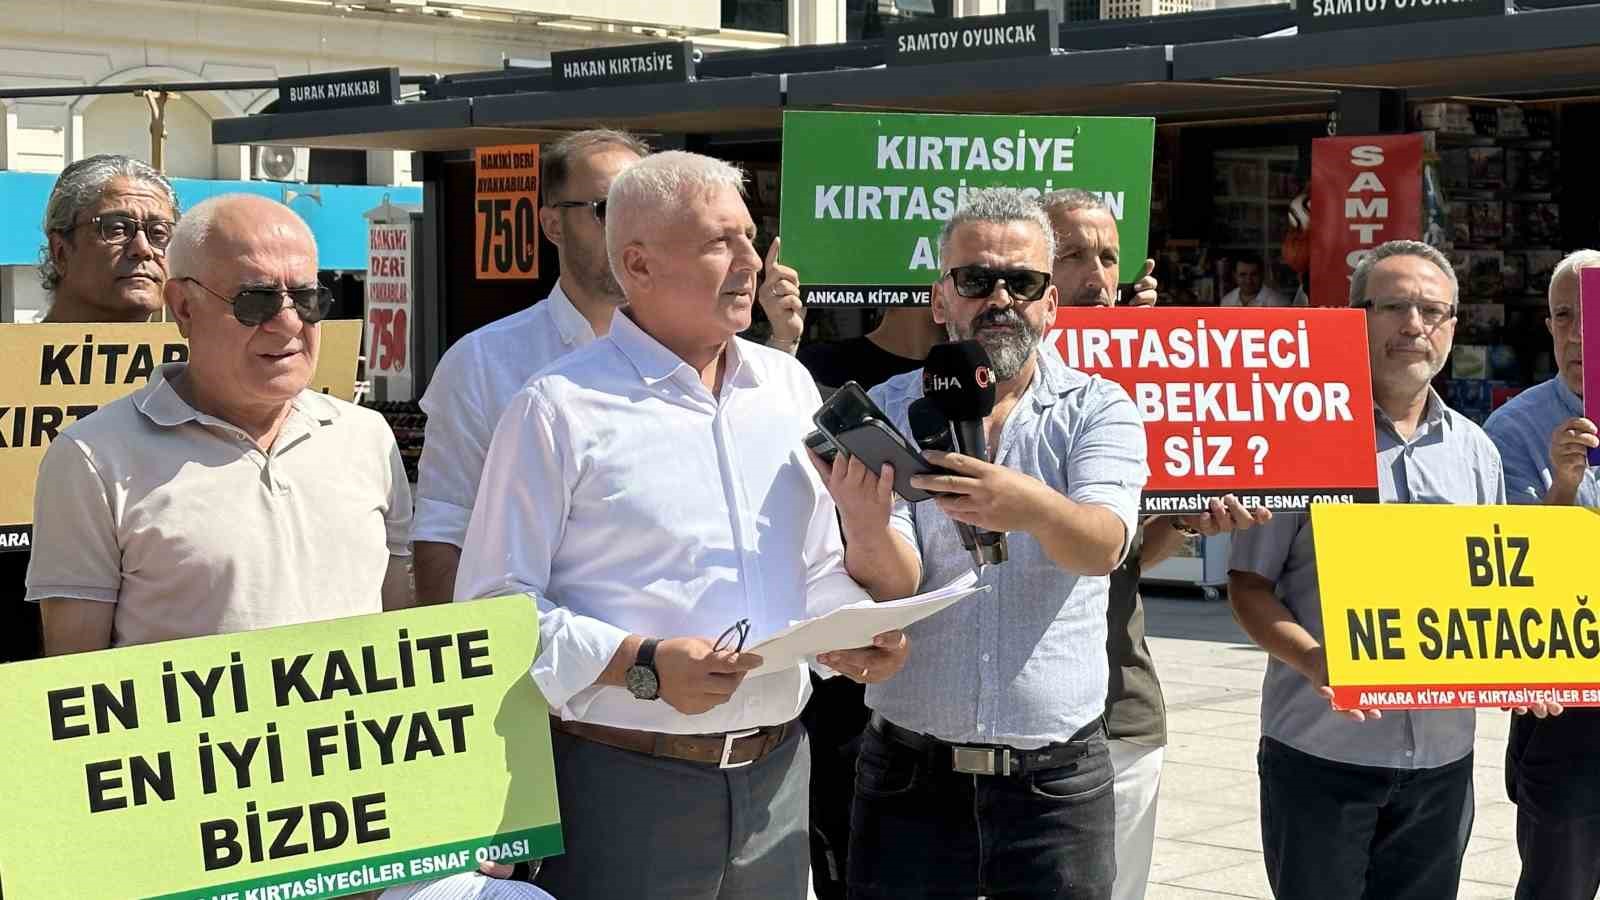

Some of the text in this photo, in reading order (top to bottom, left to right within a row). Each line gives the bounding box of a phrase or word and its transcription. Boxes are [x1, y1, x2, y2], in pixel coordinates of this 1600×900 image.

[898, 24, 1036, 52] SAMTOY OYUNCAK
[563, 51, 673, 78] HAKAN KIRTASİYE
[290, 80, 380, 102] BURAK AYAKKABI
[877, 129, 1075, 172] KIRTASİYE
[477, 197, 535, 273] 750
[1345, 145, 1389, 280] SAMT
[371, 256, 405, 277] DERİ
[806, 289, 930, 304] ANKARA KİTAP VE
[933, 374, 962, 390] İHA
[1136, 373, 1353, 422] BEKLİYOR
[1164, 427, 1235, 477] SİZ
[1247, 436, 1269, 476] ?
[1265, 495, 1309, 509] ESNAF
[1466, 524, 1534, 587] BİZ
[1346, 595, 1600, 661] NE SATACAĞ
[46, 628, 493, 741] EN İYİ KALİTE
[1360, 687, 1600, 705] ANKARA KİTAP VE KIRTASİYECİLER ES
[84, 704, 474, 813] EN İYİ FİYAT
[199, 792, 391, 872] BİZDE
[245, 839, 530, 900] KIRTASİYECİLER ESNAF ODASI
